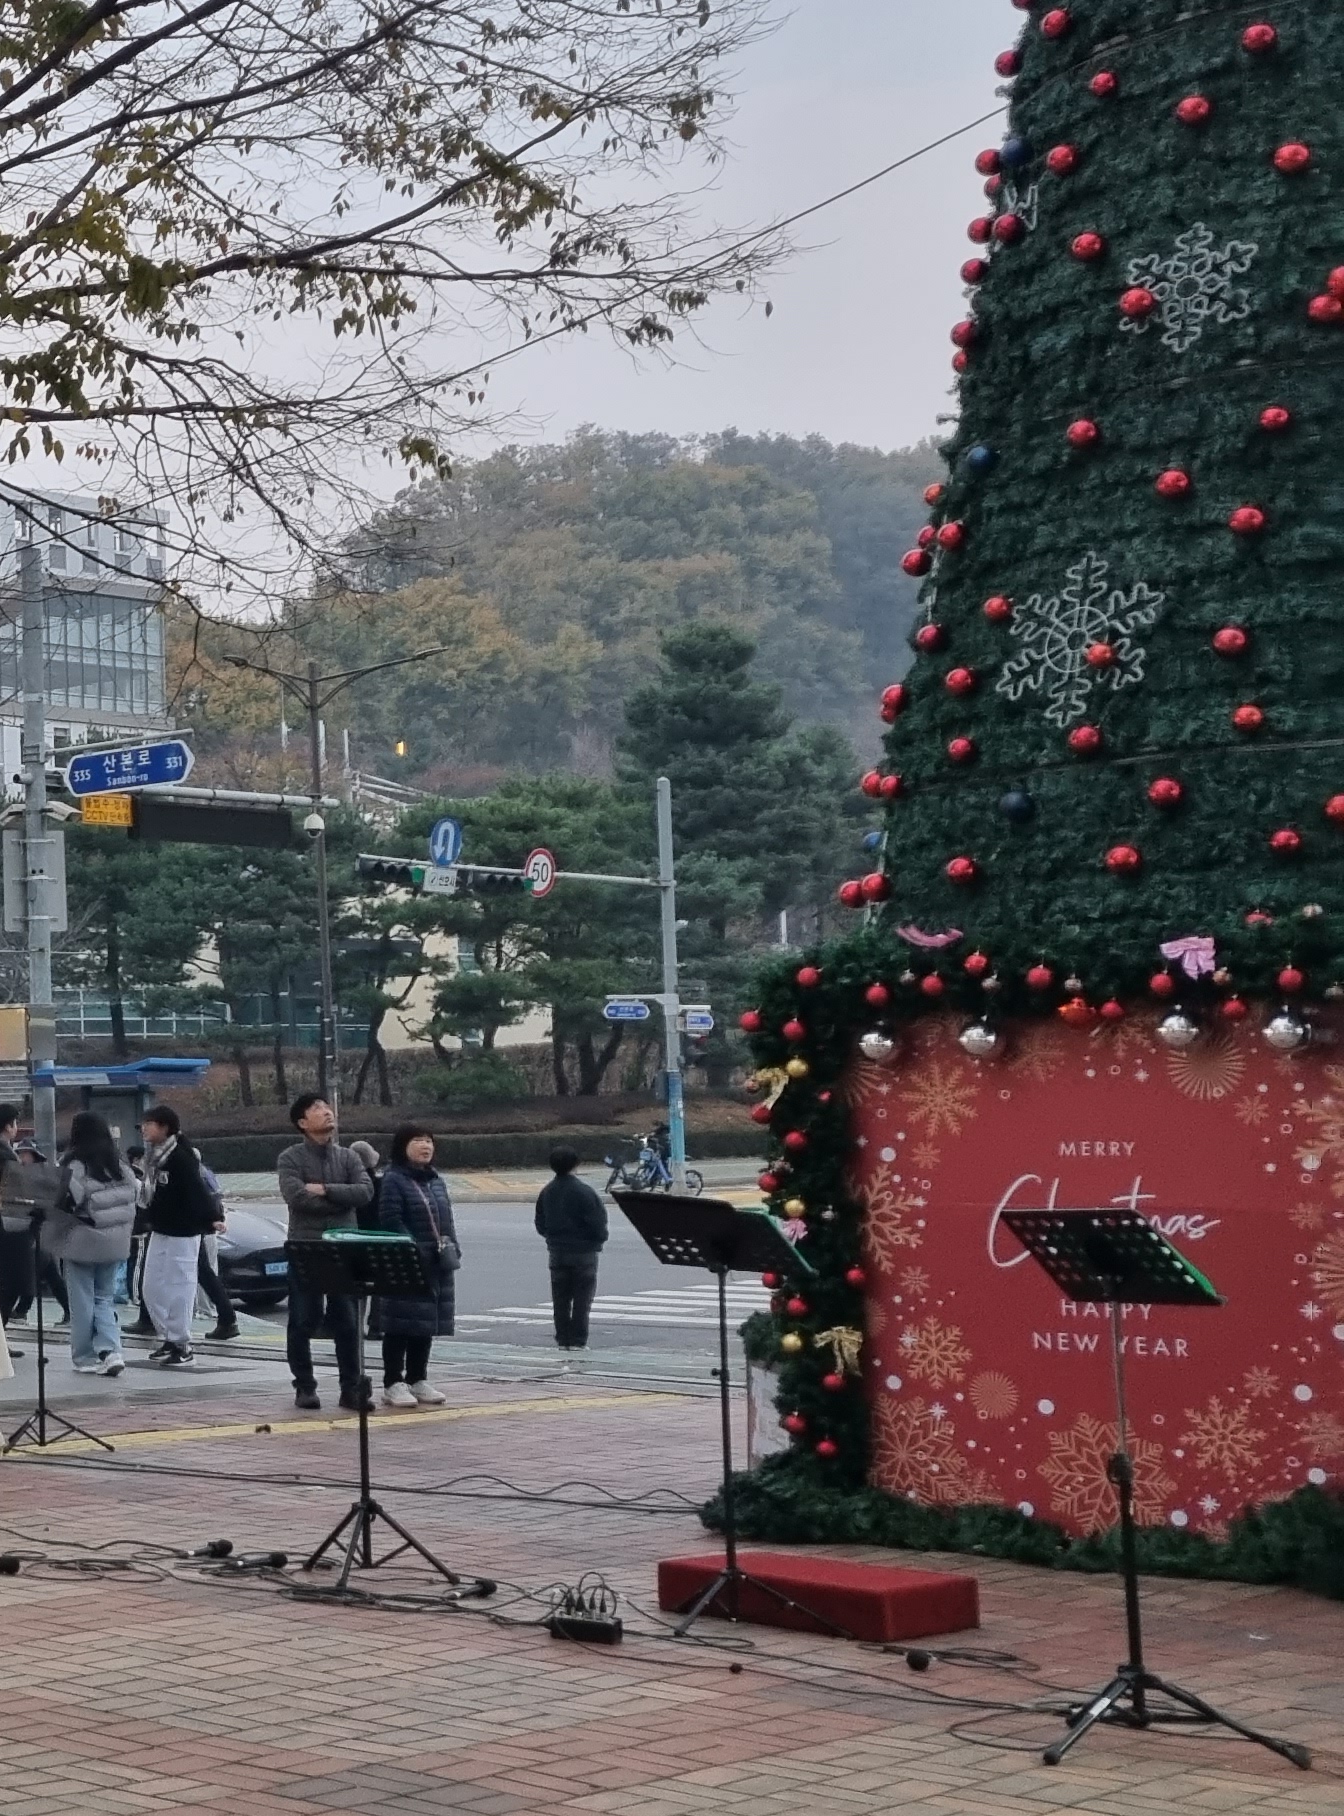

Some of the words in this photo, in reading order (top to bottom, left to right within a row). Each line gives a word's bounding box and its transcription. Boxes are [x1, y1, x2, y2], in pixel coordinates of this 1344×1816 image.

[74, 769, 91, 782] 335
[102, 749, 152, 774] 산본로
[166, 755, 183, 769] 331
[107, 773, 149, 787] Sanbon-ro
[532, 862, 549, 883] 50
[1059, 1141, 1136, 1157] MERRY
[1032, 1331, 1100, 1353] NEW
